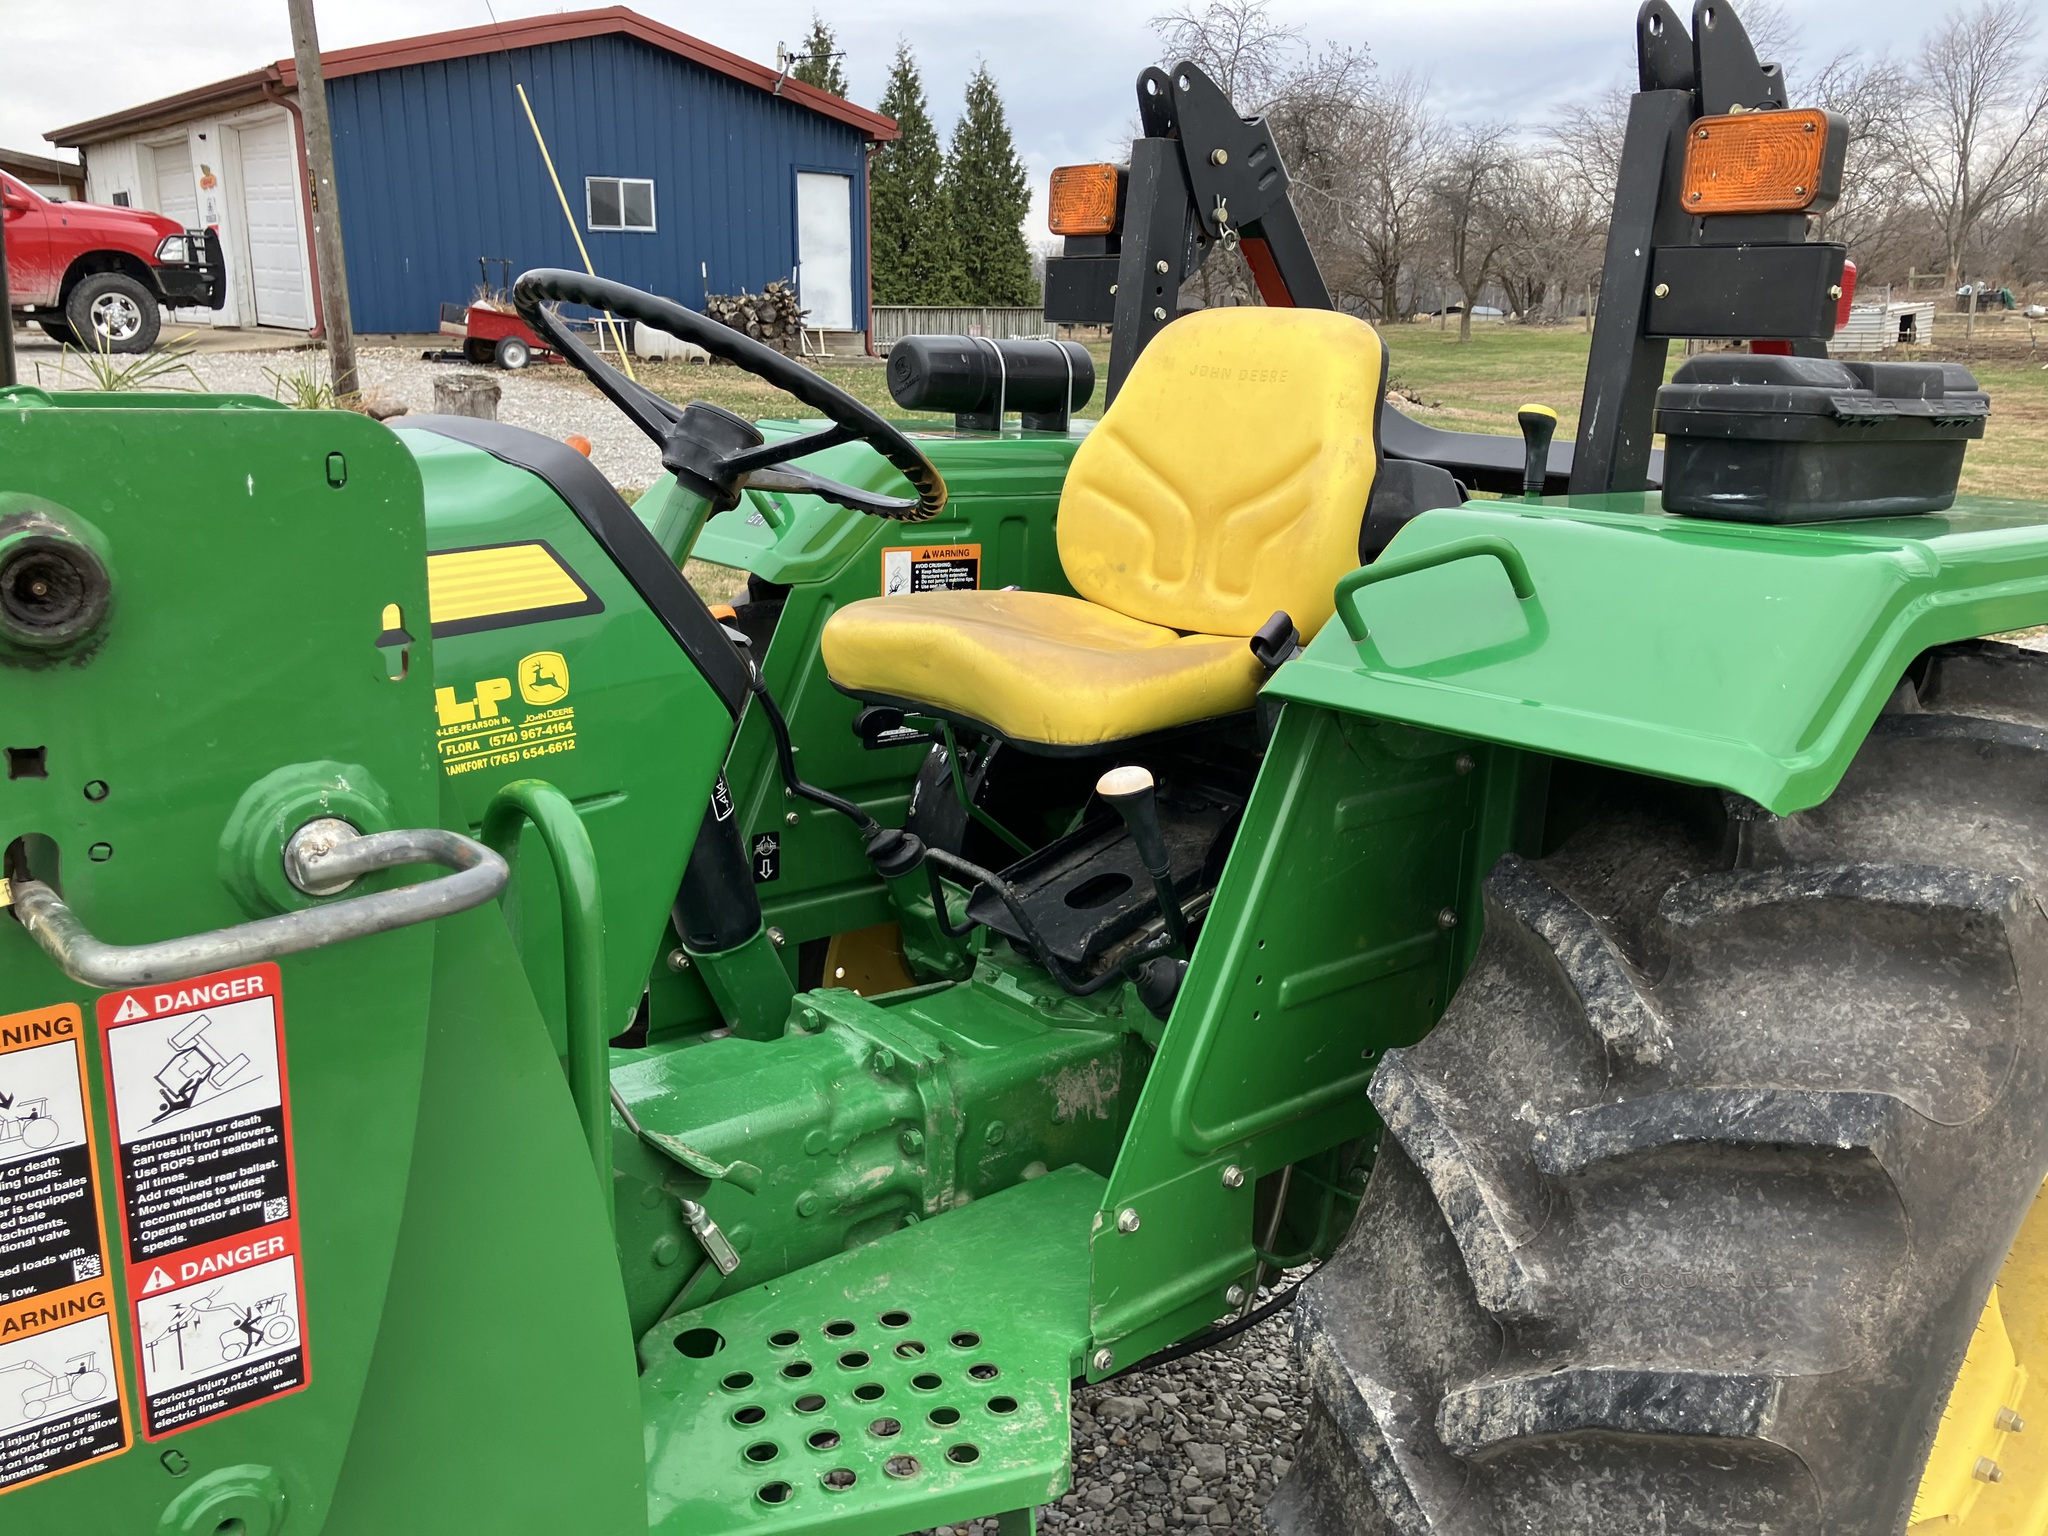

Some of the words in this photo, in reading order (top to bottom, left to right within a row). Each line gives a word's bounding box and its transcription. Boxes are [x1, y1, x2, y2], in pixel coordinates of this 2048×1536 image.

[1190, 364, 1231, 380] JOHN
[1238, 370, 1289, 382] DEERE
[932, 549, 970, 558] WARNING
[524, 712, 546, 723] JOHN
[547, 707, 574, 718] DEERE
[446, 740, 480, 756] FLORA
[489, 731, 518, 747] (574)
[521, 721, 573, 741] 967-4164
[490, 751, 520, 767] (765)
[523, 739, 575, 760] 654-6612
[154, 975, 264, 1014] DANGER
[0, 1017, 74, 1047] NING
[132, 1136, 178, 1154] Serious
[180, 1127, 213, 1144] injury
[215, 1124, 228, 1133] or
[230, 1114, 261, 1130] death
[133, 1156, 155, 1167] can
[158, 1144, 191, 1160] result
[194, 1137, 221, 1151] from
[223, 1125, 275, 1144] rollovers.
[7, 1166, 21, 1176] or
[24, 1156, 60, 1172] death
[135, 1168, 158, 1179] Use
[160, 1156, 195, 1173] ROPS
[197, 1150, 219, 1162] and
[222, 1137, 266, 1156] seatbelt
[267, 1134, 279, 1144] at
[15, 1184, 51, 1202] round
[54, 1176, 87, 1192] bales
[24, 1168, 62, 1184] loads:
[136, 1180, 150, 1192] all
[152, 1172, 188, 1187] times.
[138, 1189, 161, 1204] Add
[164, 1177, 212, 1197] required
[214, 1171, 237, 1183] rear
[240, 1159, 279, 1177] ballast.
[12, 1205, 23, 1214] is
[26, 1188, 84, 1210] equipped
[138, 1201, 170, 1216] Move
[173, 1189, 212, 1207] wheels
[215, 1186, 226, 1196] to
[229, 1174, 265, 1191] widest
[140, 1199, 221, 1228] recommended
[224, 1188, 265, 1205] setting.
[19, 1211, 46, 1225] bale
[141, 1222, 187, 1241] Operate
[190, 1209, 227, 1227] tractor
[230, 1206, 240, 1216] at
[242, 1201, 262, 1212] low
[39, 1228, 71, 1243] valve
[143, 1235, 187, 1254] speeds.
[23, 1256, 57, 1272] loads
[59, 1247, 85, 1261] with
[181, 1236, 285, 1281] DANGER
[12, 1284, 37, 1298] low.
[1619, 1271, 1810, 1289] GOODYEAR
[152, 1387, 195, 1408] Serious
[198, 1375, 228, 1394] injury
[231, 1370, 244, 1380] or
[245, 1360, 276, 1376] death
[278, 1354, 297, 1365] can
[154, 1402, 186, 1418] result
[188, 1392, 214, 1407] from
[216, 1378, 258, 1397] contact
[261, 1368, 283, 1382] with
[155, 1409, 196, 1428] electric
[199, 1399, 228, 1414] lines.
[8, 1430, 41, 1447] injury
[43, 1421, 71, 1436] from
[73, 1411, 101, 1426] falls:
[9, 1442, 40, 1457] work
[42, 1432, 69, 1446] from
[72, 1427, 85, 1437] or
[88, 1416, 118, 1432] allow
[7, 1459, 22, 1470] on
[24, 1446, 63, 1464] loader
[64, 1441, 77, 1451] or
[80, 1435, 94, 1446] its
